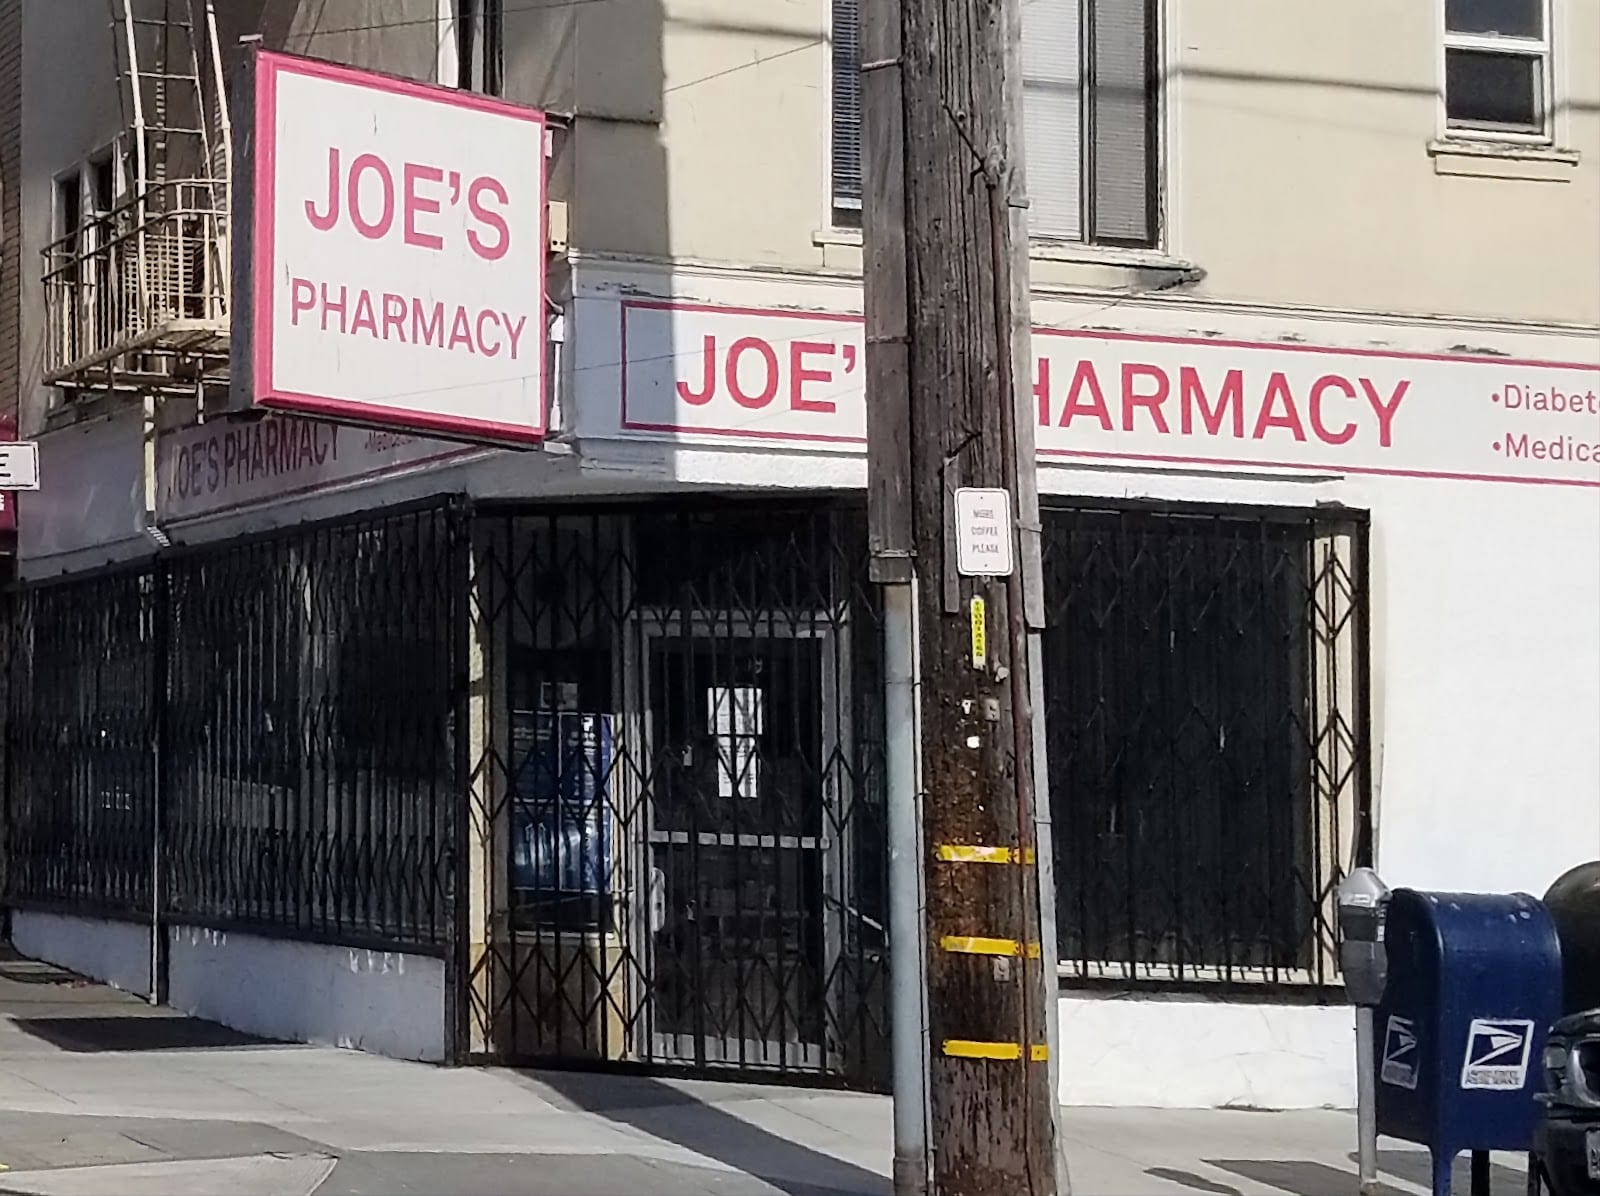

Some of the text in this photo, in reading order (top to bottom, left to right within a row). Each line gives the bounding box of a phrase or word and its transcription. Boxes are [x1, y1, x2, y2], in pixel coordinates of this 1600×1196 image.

[304, 147, 510, 261] JOE'S
[291, 277, 527, 360] PHARMACY
[676, 335, 1411, 448] JOE' ARMACY
[1504, 384, 1600, 415] Diabet
[223, 416, 339, 489] PHARMACY
